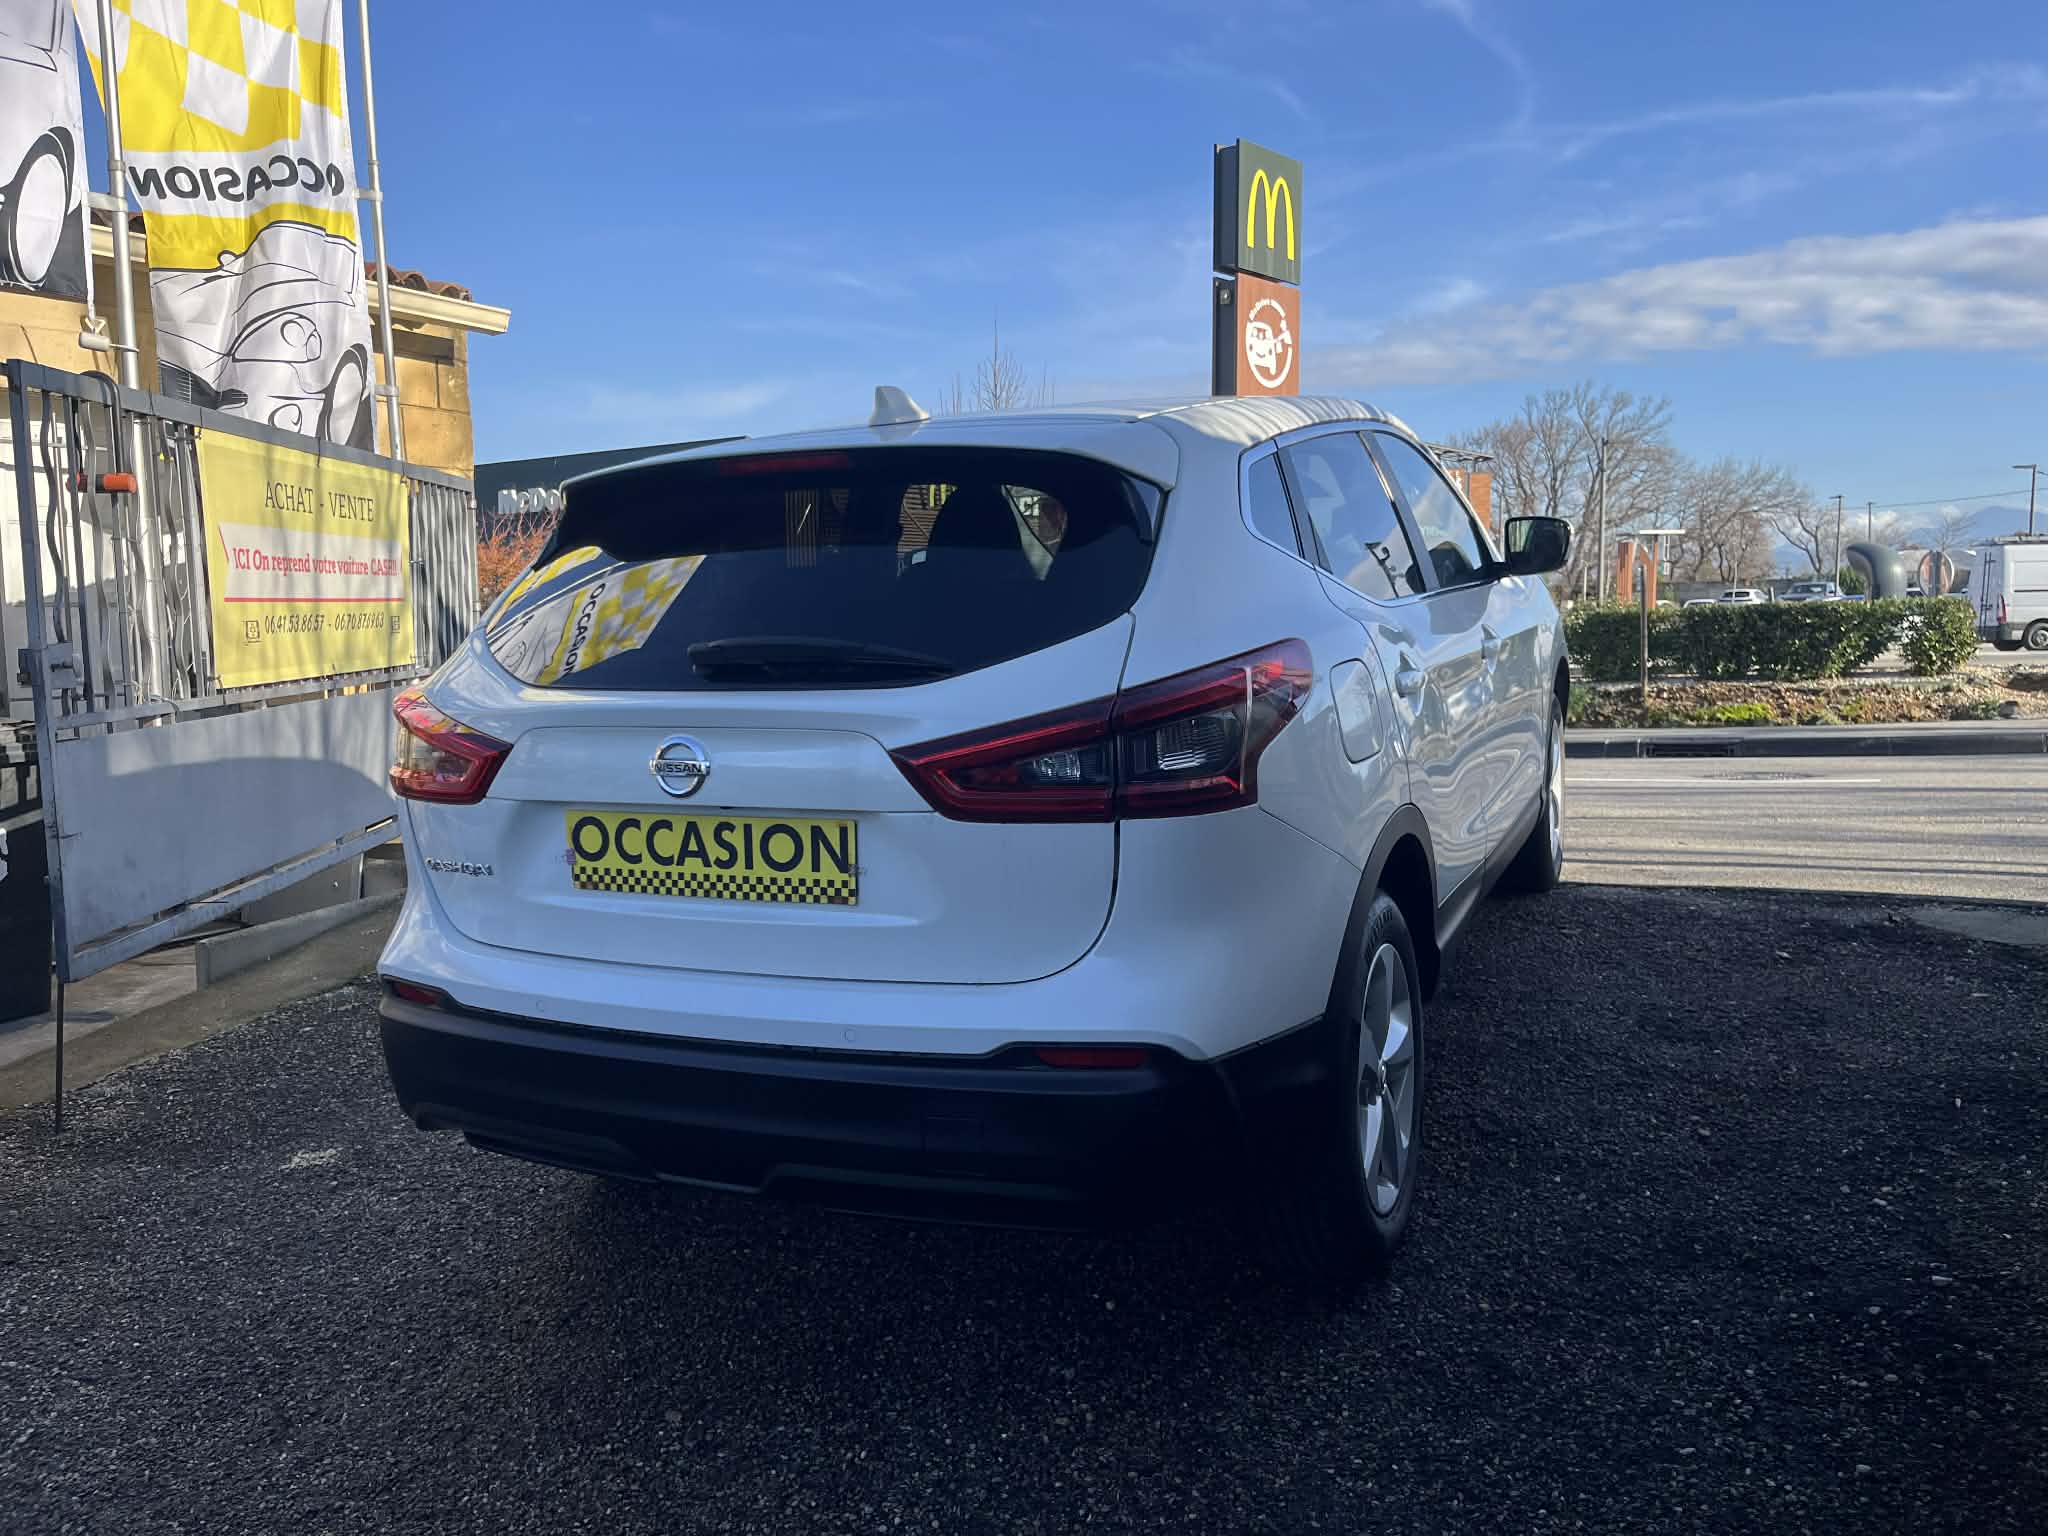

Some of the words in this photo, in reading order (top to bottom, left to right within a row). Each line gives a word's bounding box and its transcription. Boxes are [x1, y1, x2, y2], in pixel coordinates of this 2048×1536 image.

[265, 480, 314, 514] ACHAT
[328, 491, 375, 522] VENTE
[497, 487, 563, 514] McDo
[232, 547, 251, 571] ICI
[253, 549, 270, 571] On
[271, 552, 311, 577] reprend
[312, 555, 337, 575] votre
[337, 554, 369, 576] voiture
[654, 762, 702, 774] NISSAN
[571, 815, 849, 875] OCCASION
